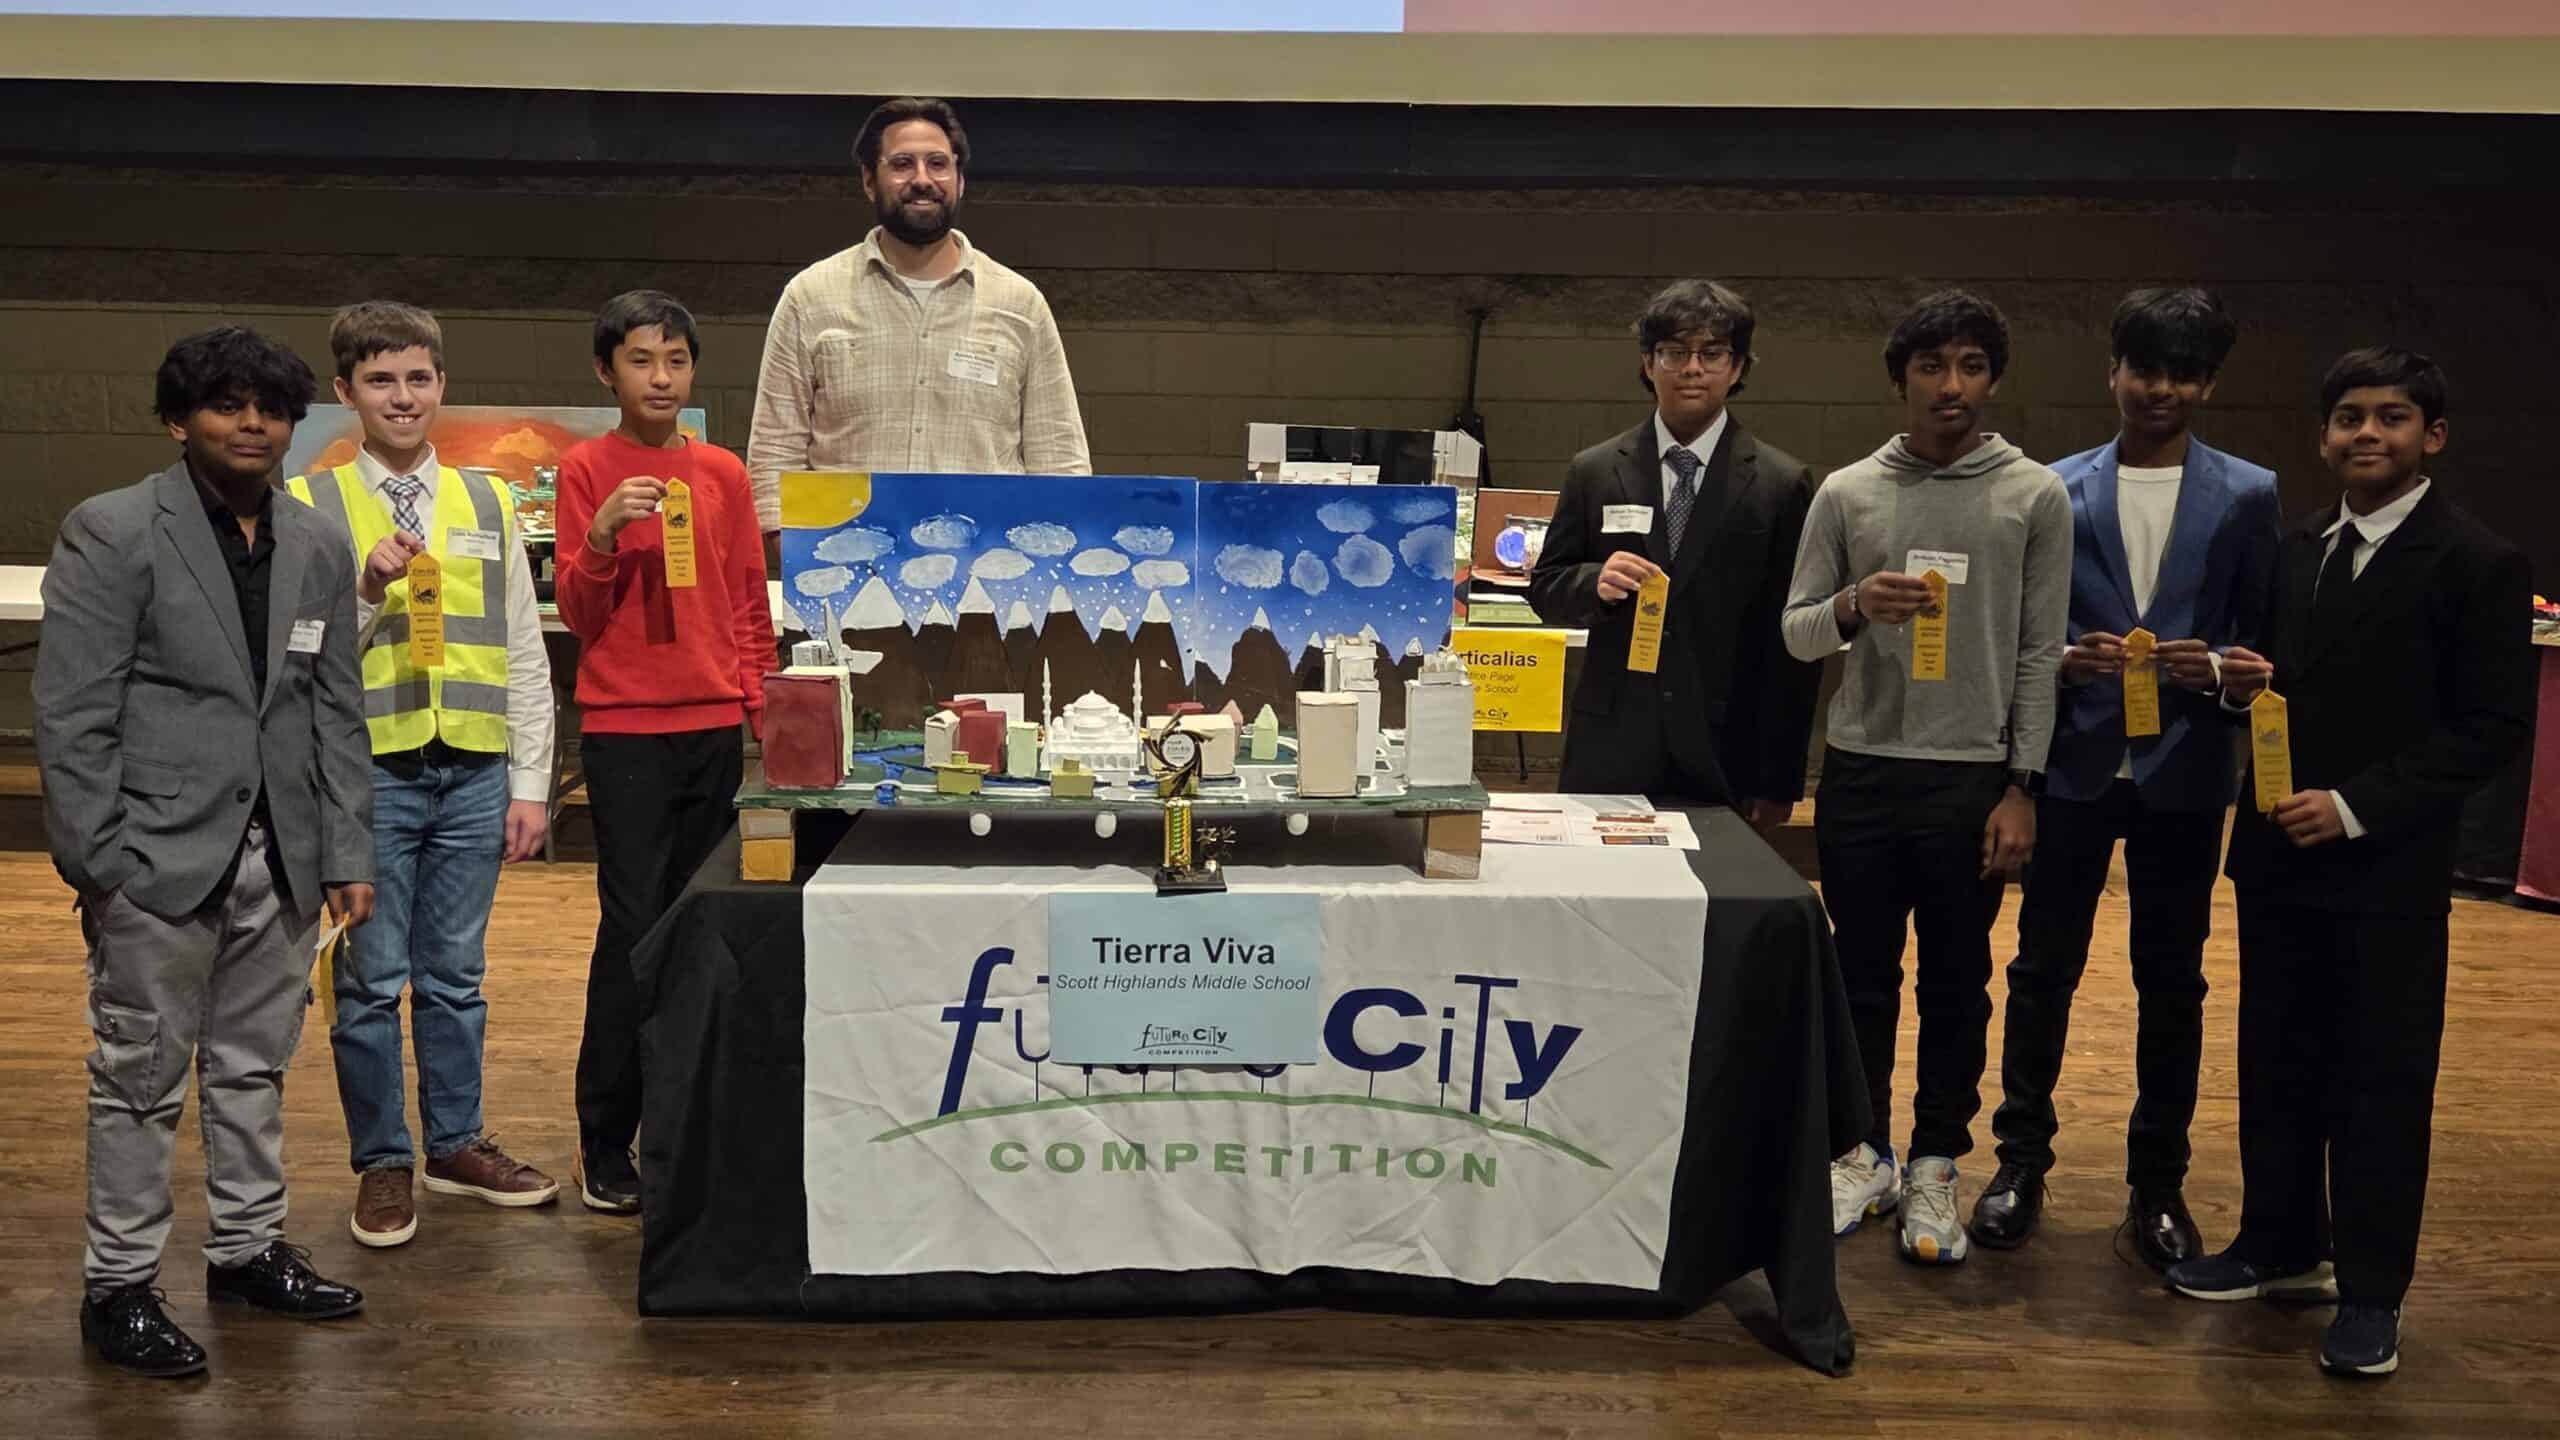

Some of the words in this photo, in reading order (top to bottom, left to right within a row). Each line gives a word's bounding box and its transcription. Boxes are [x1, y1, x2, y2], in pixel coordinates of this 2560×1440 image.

[1092, 937, 1191, 965] Tierra
[1202, 937, 1275, 966] Viva
[1055, 974, 1098, 990] Scott
[1103, 974, 1187, 993] Highlands
[1191, 975, 1248, 991] Middle
[1252, 976, 1311, 992] School
[990, 1141, 1499, 1188] COMPETITION
